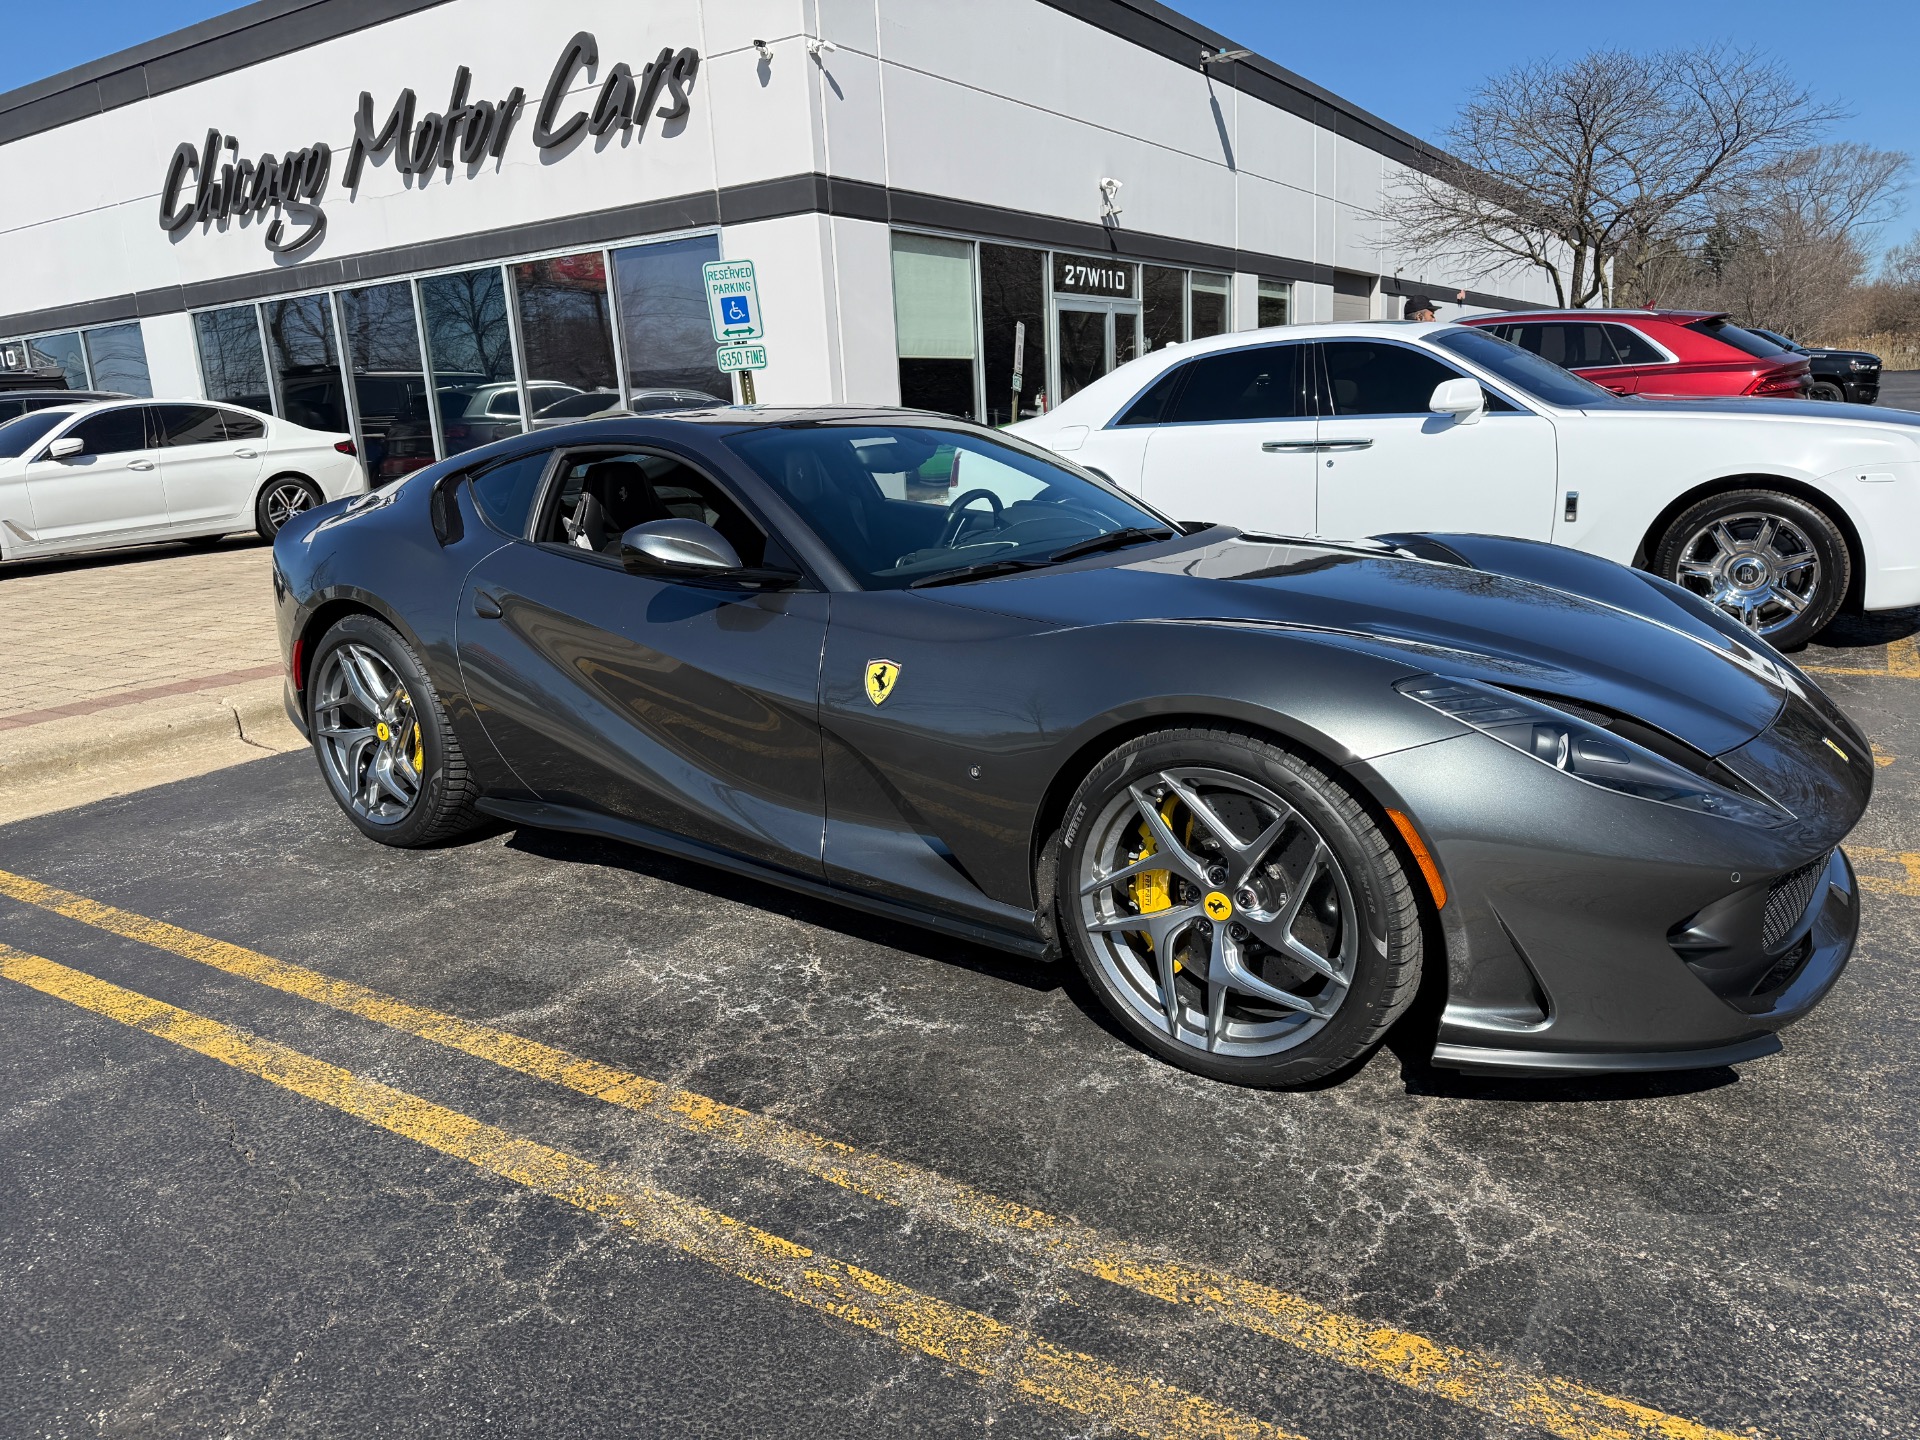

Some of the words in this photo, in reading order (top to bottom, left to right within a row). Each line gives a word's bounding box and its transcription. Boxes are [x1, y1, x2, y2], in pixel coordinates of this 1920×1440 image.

[160, 128, 329, 253] Chicago
[343, 65, 524, 188] Motor
[533, 31, 699, 148] Cars
[707, 267, 752, 281] RESERVED
[1064, 264, 1125, 290] 27W110
[712, 281, 751, 295] PARKING
[720, 352, 742, 367] $350
[745, 349, 765, 365] FINE
[1064, 801, 1088, 849] PIRELLI
[1144, 874, 1152, 907] Ferrari
